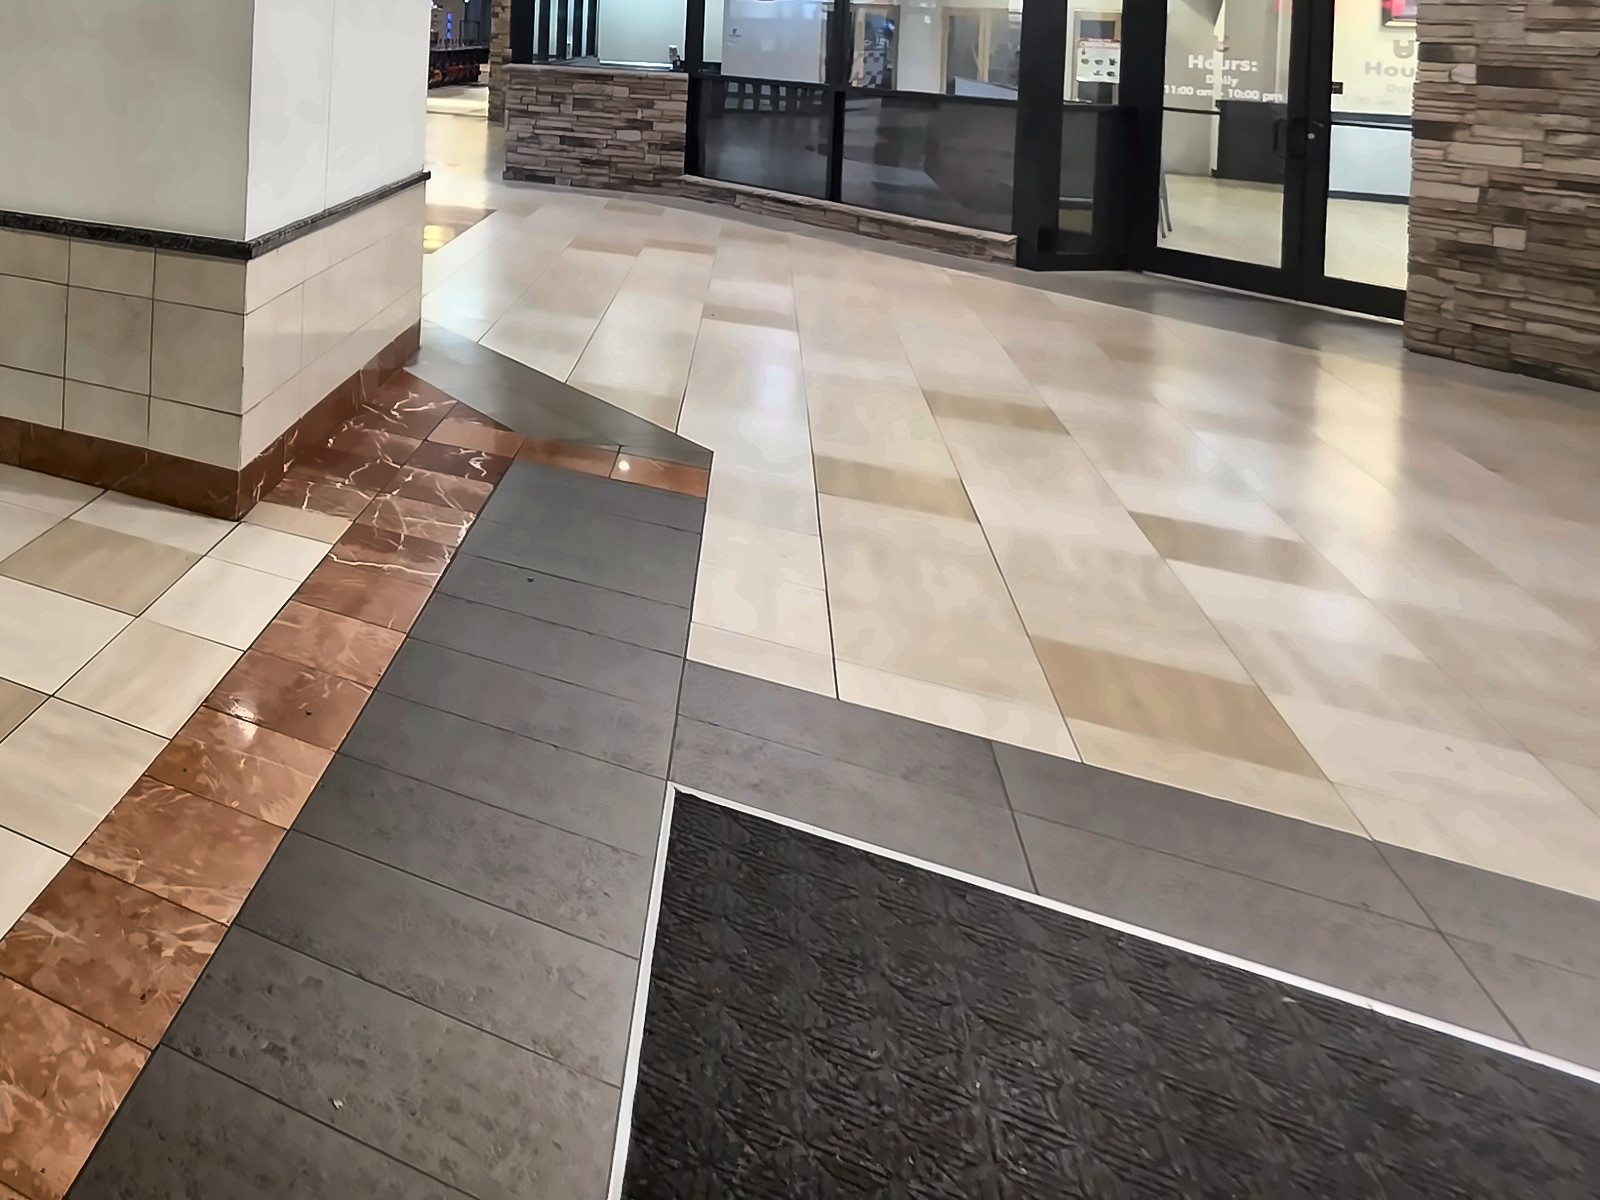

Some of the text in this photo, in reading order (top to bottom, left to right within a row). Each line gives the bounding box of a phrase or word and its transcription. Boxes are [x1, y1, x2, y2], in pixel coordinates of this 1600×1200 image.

[1364, 61, 1415, 78] Hou
[1164, 84, 1194, 95] 11:00
[1228, 88, 1260, 100] 10:00
